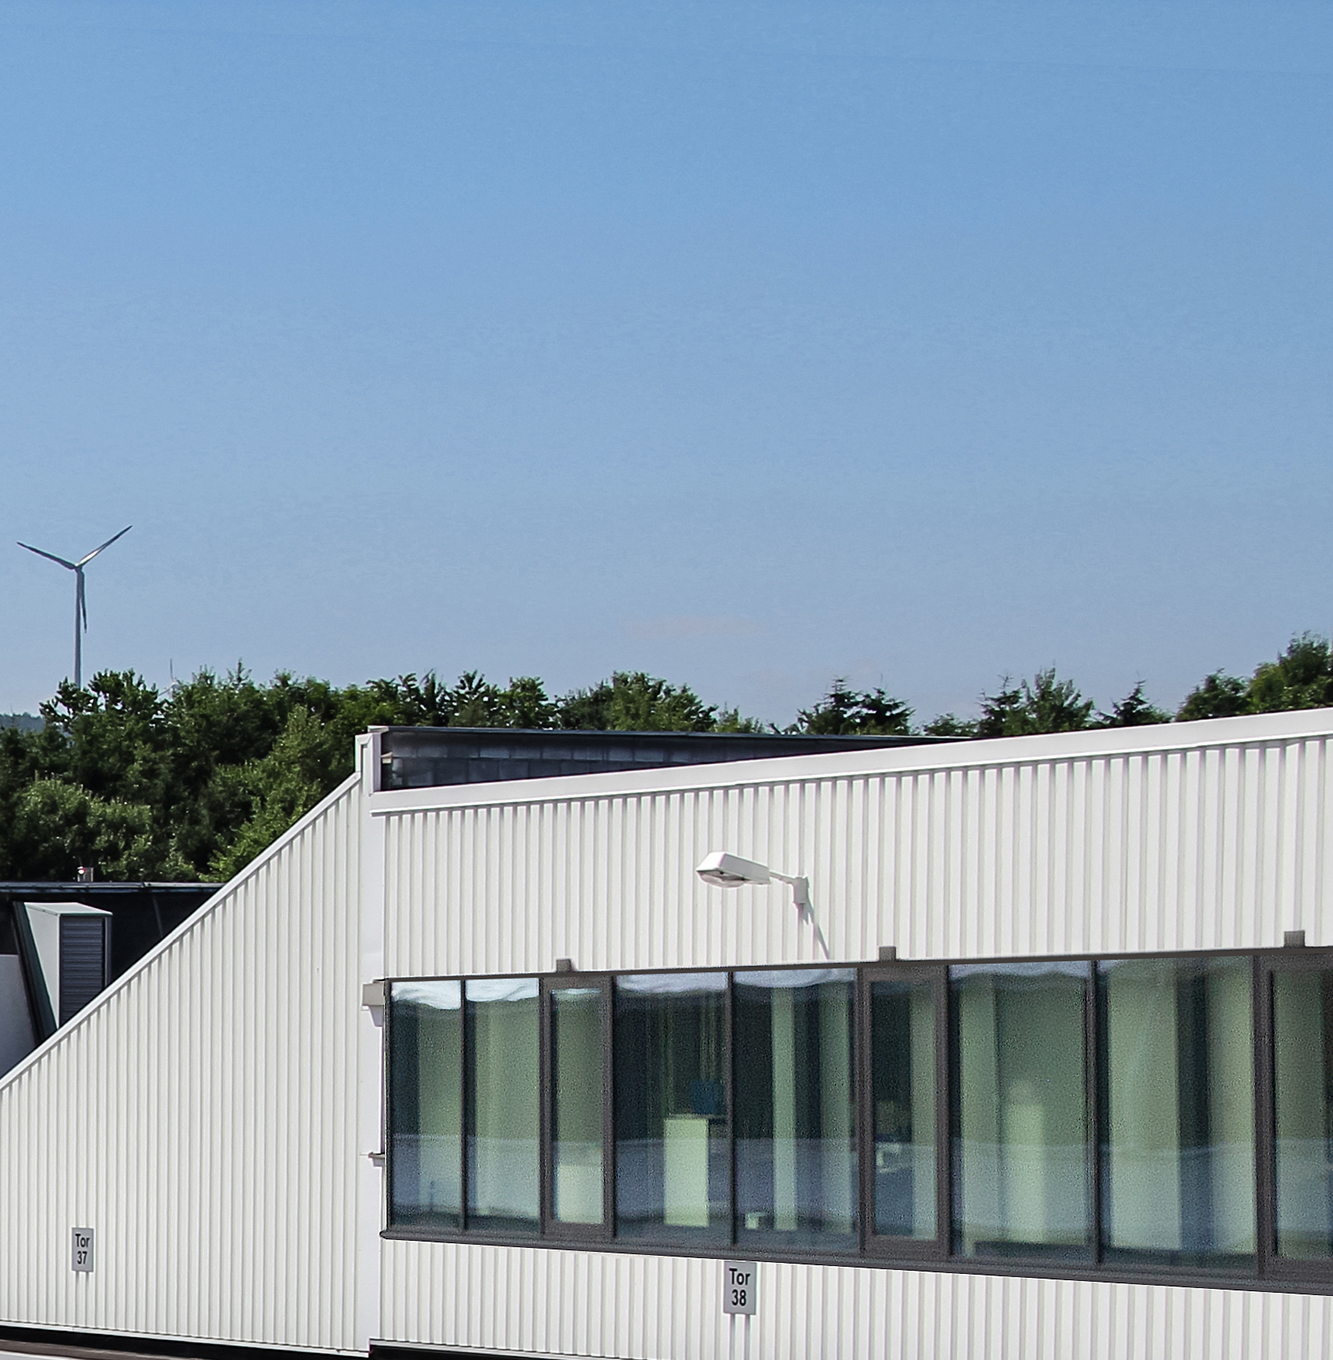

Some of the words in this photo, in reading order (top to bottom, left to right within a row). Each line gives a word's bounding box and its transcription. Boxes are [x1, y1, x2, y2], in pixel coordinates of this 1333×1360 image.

[75, 1233, 90, 1248] Tor
[76, 1250, 88, 1265] 37
[728, 1267, 751, 1286] Tor
[731, 1288, 747, 1307] 38
